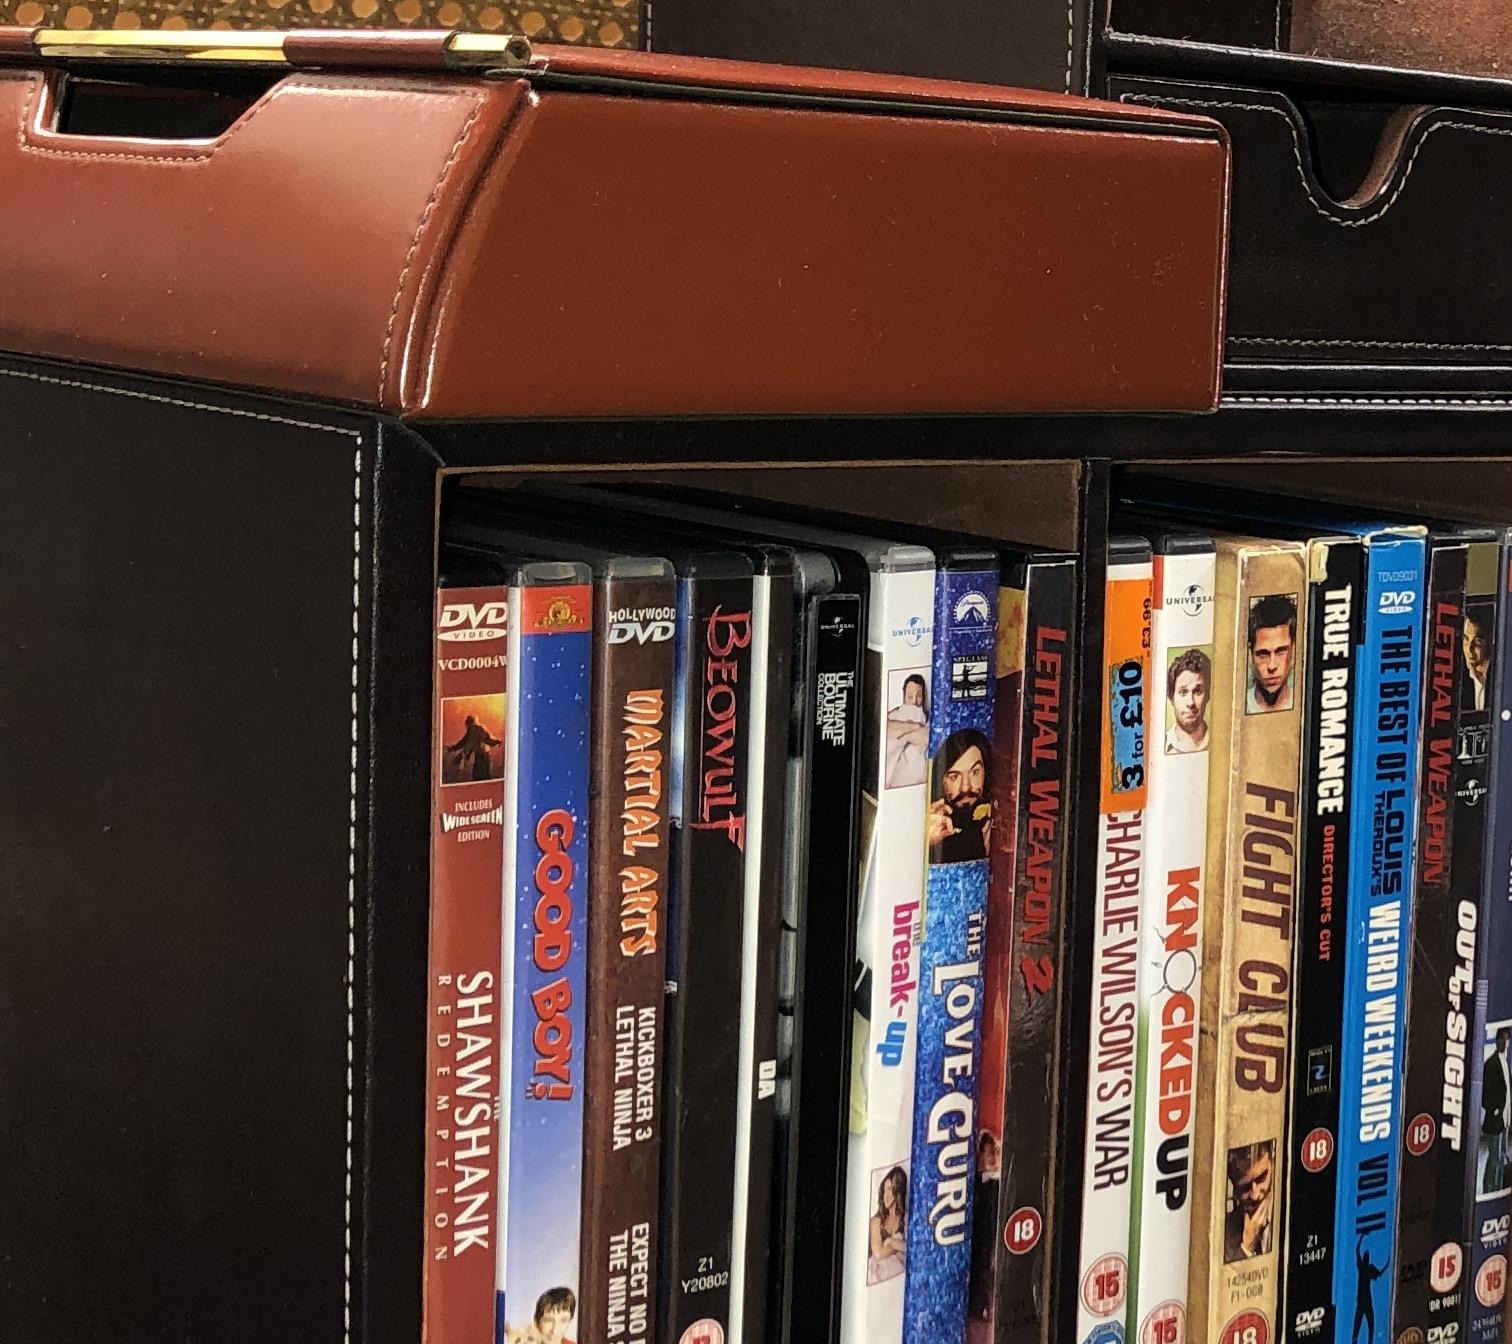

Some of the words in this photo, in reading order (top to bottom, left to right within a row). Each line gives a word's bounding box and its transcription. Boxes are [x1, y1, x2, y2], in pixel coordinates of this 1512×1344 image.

[439, 602, 507, 629] DVD
[608, 607, 676, 623] HOLLYWOOD
[608, 622, 675, 645] DVD
[1380, 623, 1414, 675] THE
[821, 672, 837, 741] BOURNE
[832, 671, 850, 747] ULTIMATE
[1377, 681, 1410, 745] BEST
[620, 688, 665, 857] MARTIAL
[1375, 751, 1408, 785] OF
[457, 829, 491, 843] EDITION
[1240, 782, 1295, 941] FIGHT
[1381, 788, 1406, 897] LOUIS
[533, 809, 575, 973] GOOD
[617, 865, 661, 958] ARTS
[965, 911, 985, 958] THE
[525, 976, 574, 1103] BOY!
[614, 1004, 635, 1084] LETHAL
[932, 960, 980, 1088] LOVE
[1234, 958, 1291, 1094] CLUB
[634, 1005, 656, 1124] KICKBOXER
[433, 974, 452, 1261] REDEMPTION
[452, 969, 495, 1258] SHAWSHANK
[612, 1088, 634, 1152] NINJA
[634, 1125, 653, 1143] 3
[1412, 1123, 1430, 1145] 18
[926, 1090, 976, 1248] GURU
[1308, 1140, 1328, 1161] 18
[607, 1229, 629, 1273] THE
[629, 1221, 650, 1297] EXPECT
[1012, 1218, 1034, 1243] 18
[605, 1279, 627, 1340] NINJA
[628, 1301, 648, 1334] NO
[1094, 1271, 1119, 1300] 15
[1153, 1315, 1177, 1344] 15
